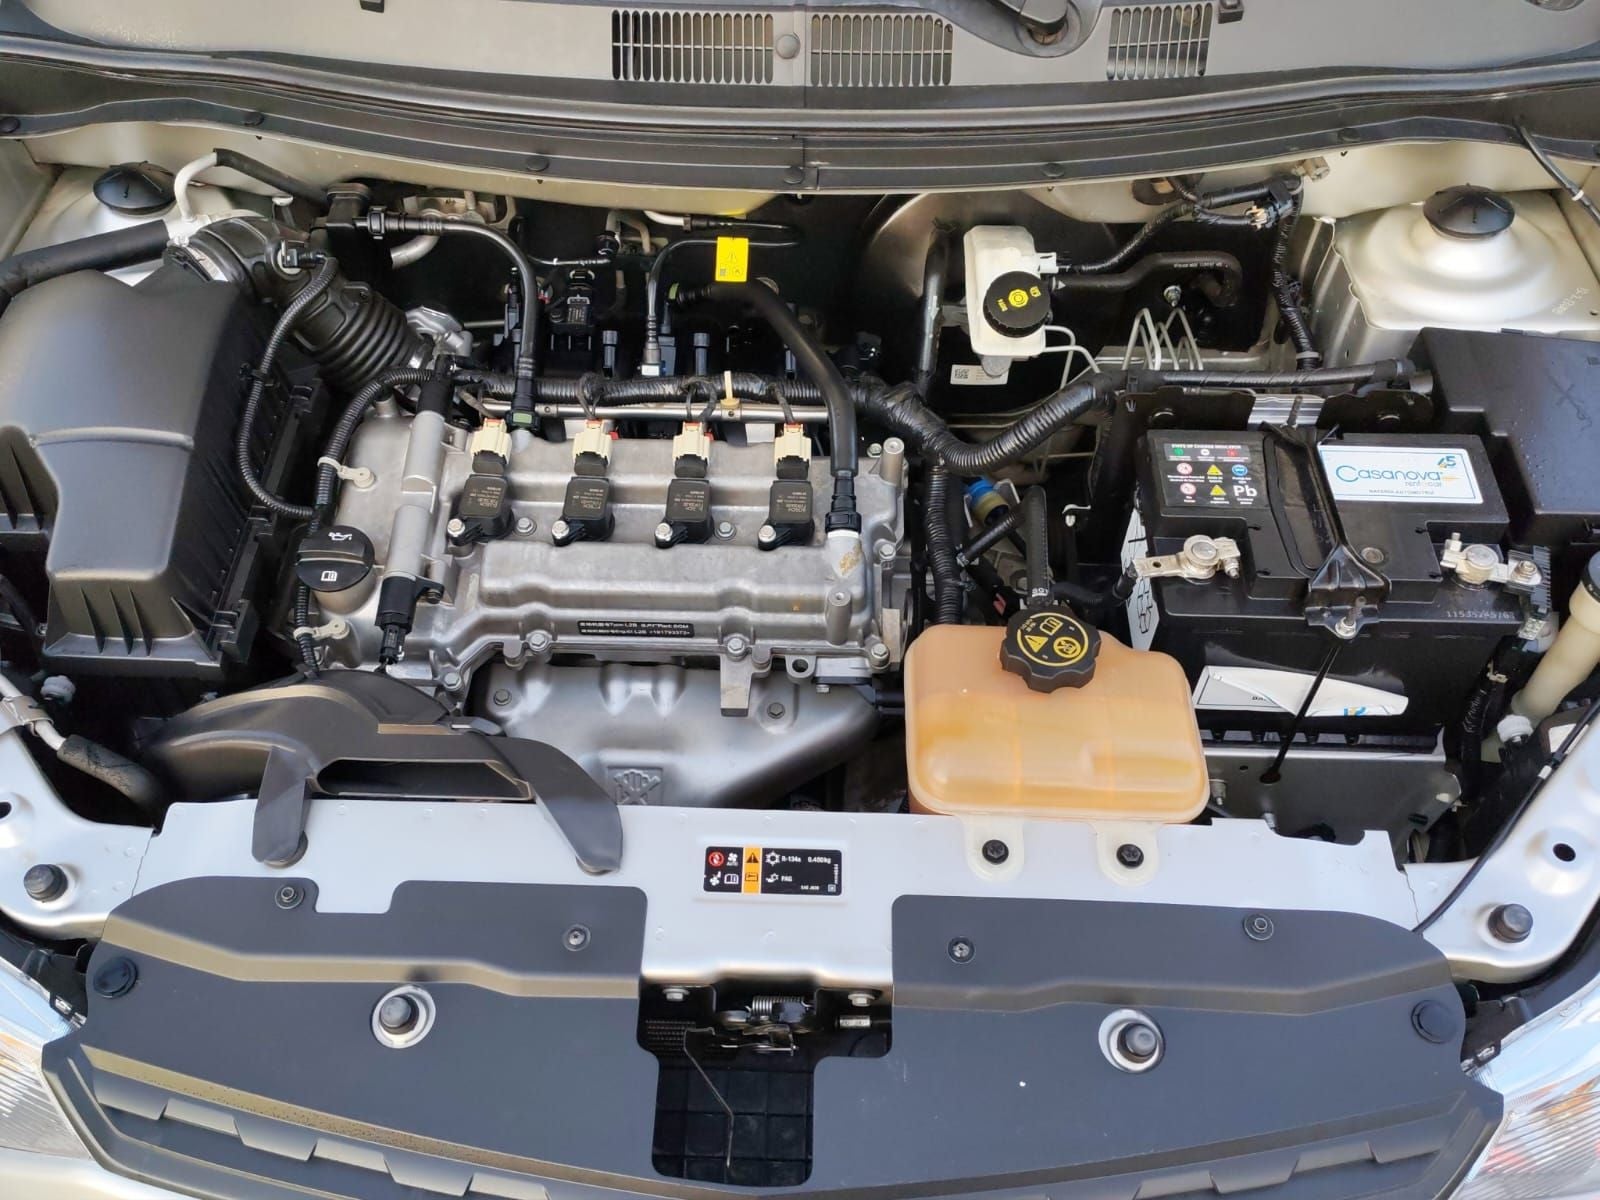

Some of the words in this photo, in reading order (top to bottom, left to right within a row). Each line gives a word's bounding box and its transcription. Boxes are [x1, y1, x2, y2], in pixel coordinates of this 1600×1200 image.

[1335, 465, 1441, 483] Casanova
[1232, 484, 1258, 497] Pb
[781, 855, 801, 863] R-134a
